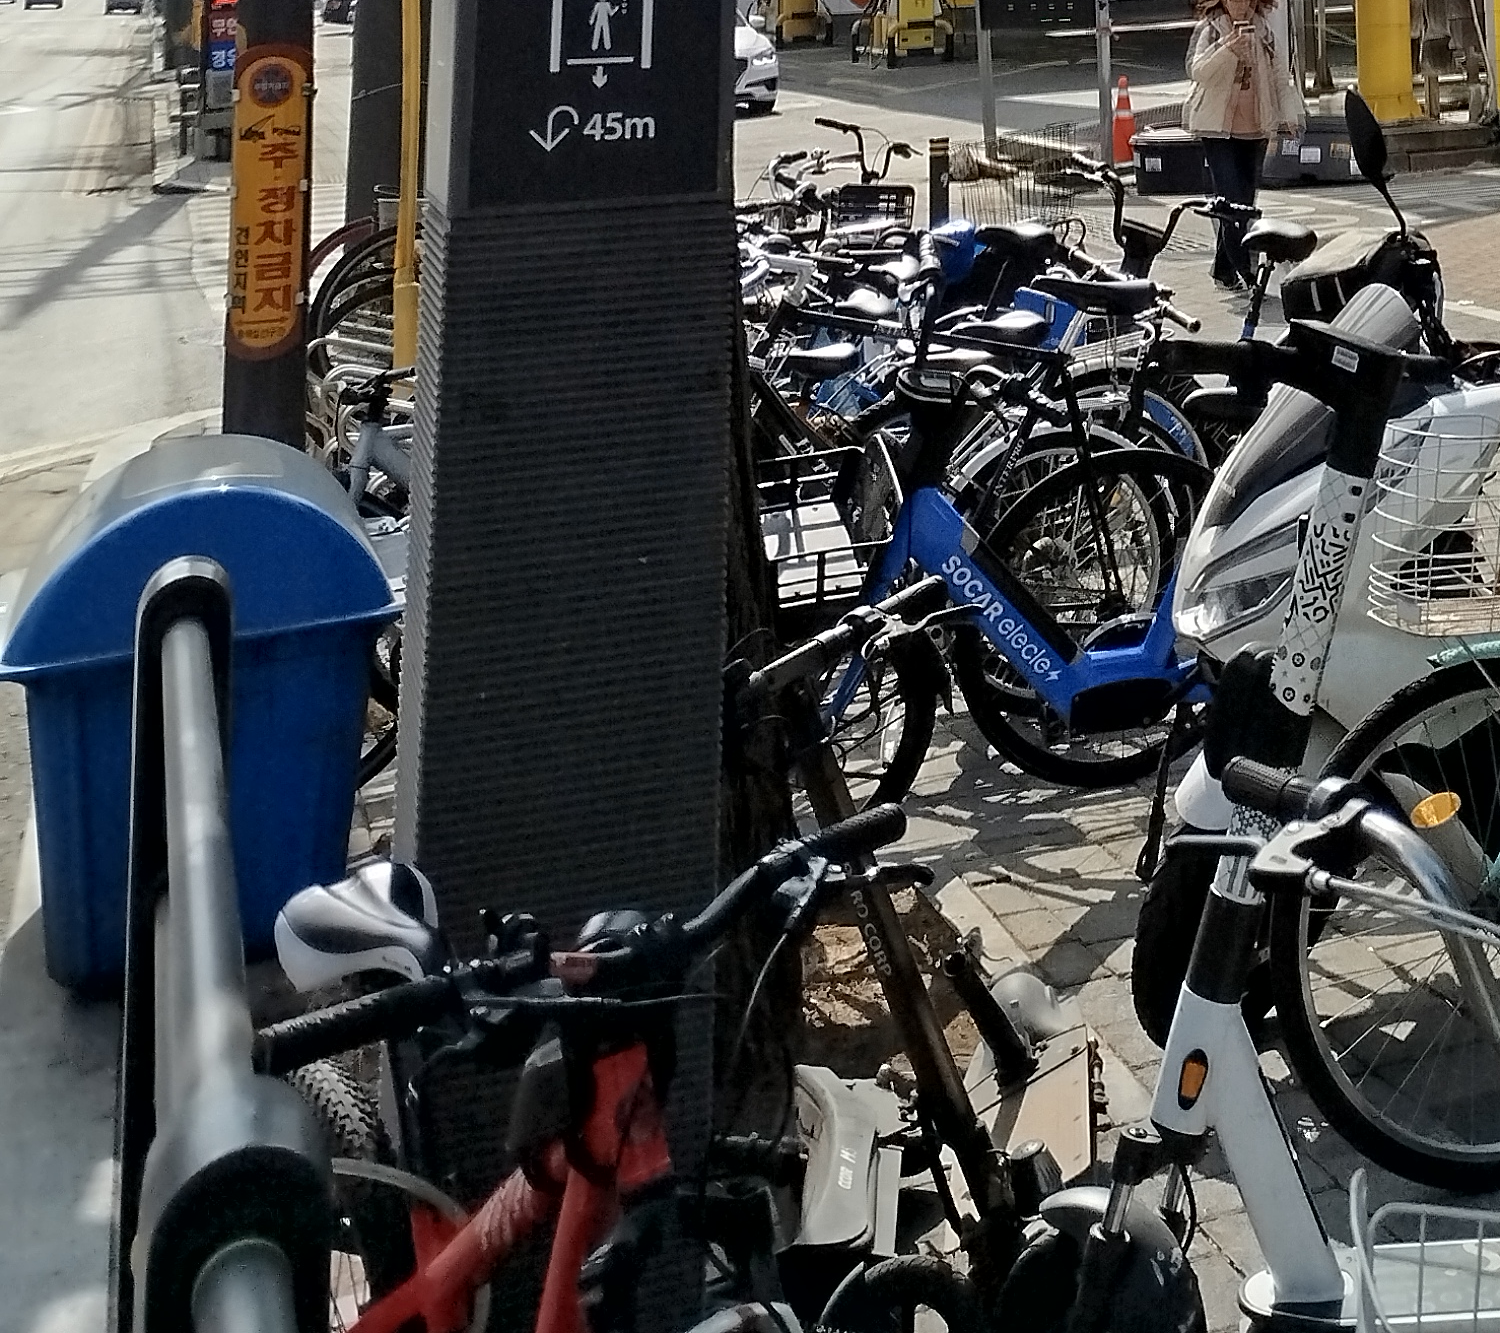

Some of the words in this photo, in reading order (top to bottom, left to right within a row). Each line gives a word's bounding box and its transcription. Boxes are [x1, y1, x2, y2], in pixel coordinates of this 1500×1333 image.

[582, 111, 656, 143] 45m
[941, 554, 1004, 623] SOCAR
[997, 617, 1051, 675] elecle
